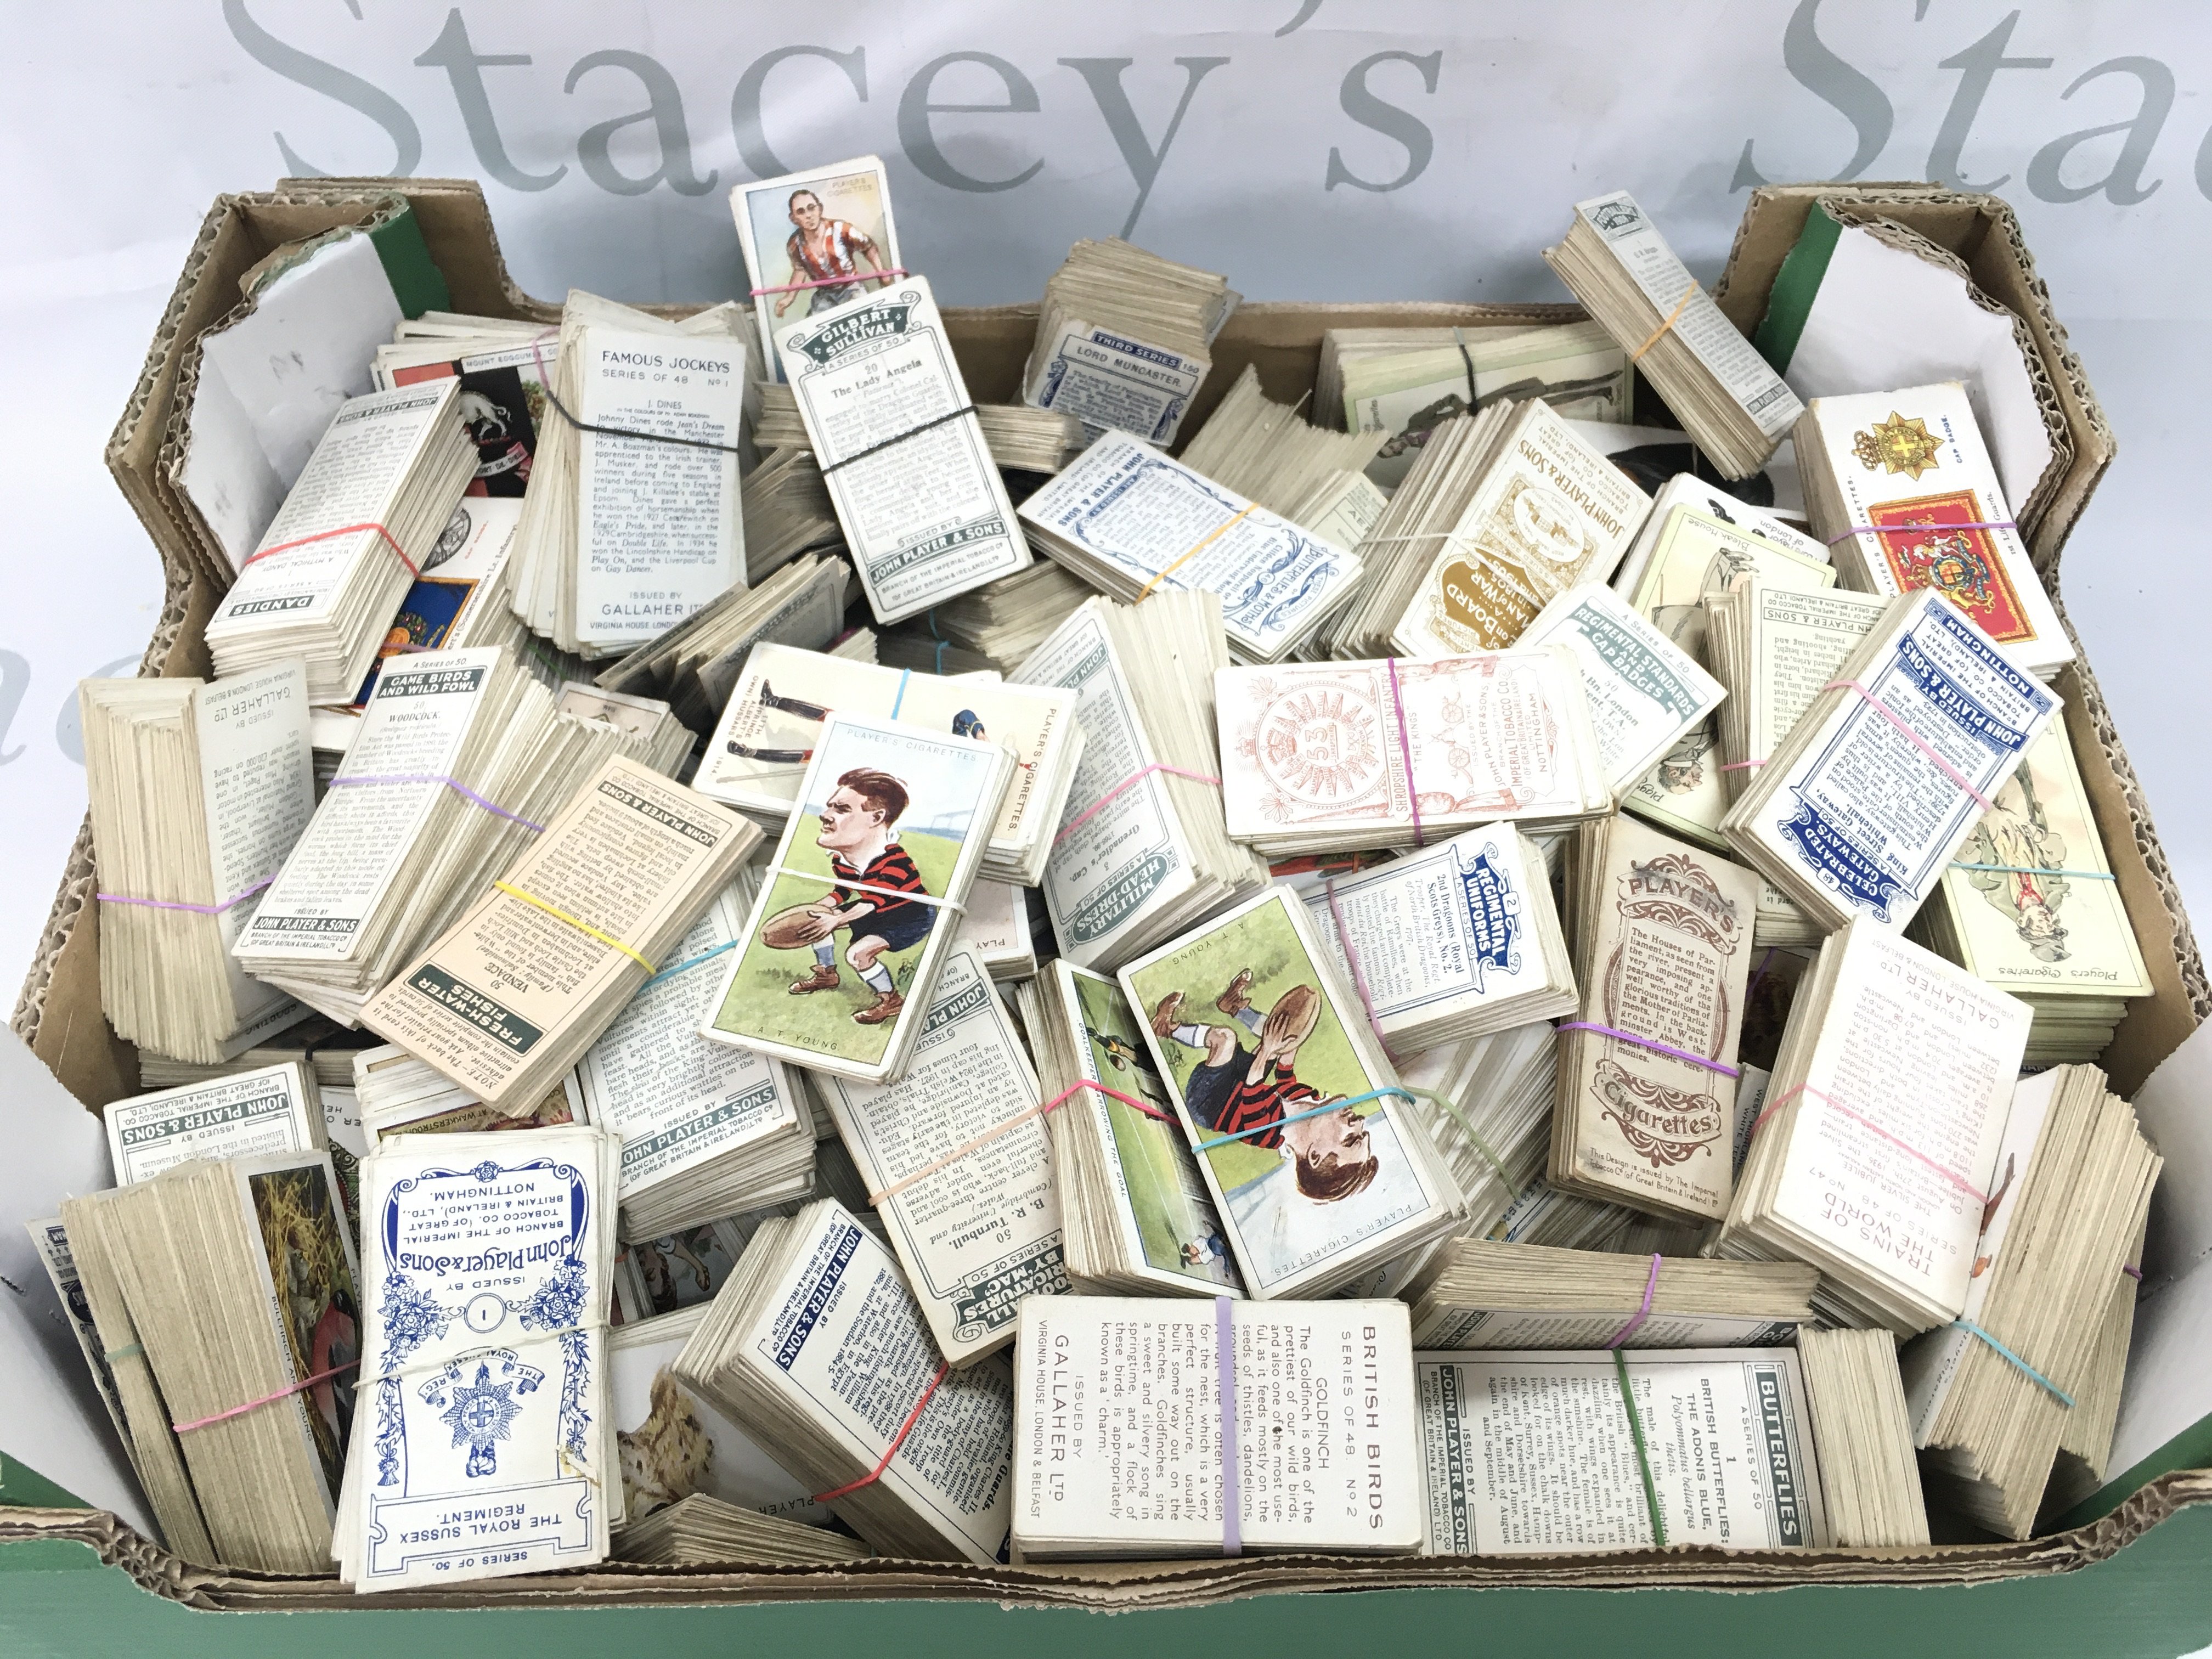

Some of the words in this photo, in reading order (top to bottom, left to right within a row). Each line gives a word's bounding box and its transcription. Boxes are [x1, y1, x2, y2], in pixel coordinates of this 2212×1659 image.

[1729, 0, 2212, 206] Sta
[818, 304, 893, 343] GILBERT
[823, 318, 898, 357] SULLIVAN
[602, 351, 663, 368] FAMOUS
[669, 357, 730, 374] JOCKEYS
[1076, 346, 1109, 363] LORD
[1096, 336, 1134, 353] THIRD
[1135, 348, 1178, 366] SERIES
[831, 383, 853, 399] The
[854, 373, 882, 391] Lady
[885, 358, 923, 380] Angela
[597, 414, 624, 424] Johnny
[629, 416, 651, 425] Dines
[656, 418, 674, 427] rode
[657, 400, 682, 409] DINES
[1119, 452, 1148, 472] JOHN
[1514, 438, 1550, 474] SONS
[1545, 463, 1559, 479] &
[1953, 447, 1962, 464] CAP
[1080, 498, 1093, 506] &
[1088, 472, 1125, 499] PLAYER
[1550, 471, 1599, 516] PLAYER
[1056, 506, 1084, 527] SONS
[1590, 505, 1624, 539] JOHN
[1686, 516, 1718, 537] House
[869, 556, 904, 582] JOHN
[902, 536, 949, 565] PLAYER
[951, 531, 965, 544] &
[964, 517, 1003, 544] SONS
[1719, 530, 1750, 552] Bleak
[1266, 548, 1324, 595] BUTTERFLIES
[1468, 570, 1501, 602] WAR
[1874, 550, 1897, 599] PLAYER'S
[231, 597, 310, 615] DANDIES
[602, 603, 683, 616] GALLAHER
[1237, 598, 1273, 627] MOTHS
[1263, 592, 1275, 601] &
[1443, 582, 1500, 635] BOARD
[1574, 605, 1643, 659] REGIMENTAL
[1640, 652, 1695, 716] STANDARDS
[1590, 629, 1616, 661] CAP
[1612, 654, 1664, 700] BADGES
[1899, 635, 1932, 679] SONS.
[1940, 616, 2032, 695] NOTTINGHAM.
[379, 686, 406, 697] AND
[405, 683, 441, 695] WILD
[439, 680, 478, 692] FOWL
[389, 674, 425, 686] GAME
[427, 670, 473, 684] BIRDS
[1926, 673, 1942, 690] &
[230, 686, 291, 715] GALLAHER
[1604, 691, 1639, 727] London
[1936, 683, 1987, 728] PLAYER
[1032, 707, 1057, 758] PLAYER'S
[1386, 723, 1401, 752] LIGHT
[1499, 697, 1515, 743] TOBACCO
[1982, 719, 2022, 747] JOHN
[1390, 755, 1408, 812] SHROPSHIRE
[1508, 744, 1522, 786] IMPERIAL
[1007, 760, 1038, 833] CIGARETTES.
[1809, 788, 1858, 828] Gateway,
[1843, 803, 1889, 845] Whitehall.
[1853, 826, 1886, 854] Street
[1090, 823, 1141, 868] Grenadier's
[1801, 826, 1880, 897] CELEBRATED
[1811, 819, 1880, 883] GATEWAYS.
[1884, 851, 1911, 874] King
[1074, 857, 1162, 932] HEAD-DRESS
[1084, 876, 1158, 938] MILITARY
[1475, 866, 1507, 956] REGIMENTAL
[1627, 864, 1736, 935] PLAYER'S
[1465, 877, 1491, 952] UNIFORMS
[1441, 893, 1457, 939] Dragoons
[1449, 940, 1465, 974] (Royal
[1631, 927, 1647, 940] The
[1651, 934, 1681, 953] Houses
[1685, 947, 1694, 958] of
[483, 961, 531, 992] VENDACE
[489, 978, 505, 990] 50
[1628, 953, 1647, 970] very
[1656, 964, 1693, 987] imposing
[1998, 962, 2061, 979] Cigarettes
[2070, 966, 2118, 981] Player's
[414, 977, 526, 1046] FRESH-WATER
[449, 983, 509, 1022] FISHES
[1640, 995, 1671, 1015] Mother
[1906, 970, 1999, 1030] GALLAHER
[1077, 1022, 1098, 1081] GOALKEEPER
[650, 1104, 674, 1121] front
[675, 1098, 686, 1109] of
[687, 1092, 699, 1103] its
[700, 1079, 726, 1097] head.
[654, 1088, 687, 1109] curious
[690, 1072, 724, 1093] wattles
[198, 1124, 234, 1138] ISSUED
[1601, 1075, 1712, 1156] Cigarettes
[180, 1134, 192, 1142] BY
[183, 1145, 219, 1160] London
[139, 1154, 180, 1169] Museum.
[1109, 1146, 1119, 1165] THE
[1115, 1171, 1127, 1197] GOAL
[429, 1183, 534, 1200] NOTTINGHAM.
[913, 1190, 975, 1230] three-quarter
[948, 1214, 1008, 1251] Turnbull.
[1355, 1203, 1412, 1237] PLAYER'S
[1820, 1204, 1848, 1228] OF
[1824, 1190, 1893, 1238] WORLD
[835, 1227, 862, 1263] JOHN
[995, 1227, 1011, 1245] 50
[1008, 1239, 1049, 1264] SERIES
[1050, 1234, 1059, 1243] A
[1858, 1225, 1931, 1276] TRAINS
[1899, 1233, 1934, 1261] THE
[970, 1268, 989, 1283] 50
[991, 1260, 1007, 1272] OF
[806, 1261, 843, 1314] PLAYER
[272, 1296, 292, 1362] BULLFINCH
[800, 1311, 814, 1325] &
[842, 1316, 863, 1347] Soudan
[852, 1307, 878, 1347] Waterloo,
[777, 1323, 809, 1367] SONS
[1341, 1331, 1353, 1396] SERIES
[828, 1361, 850, 1392] Egypt
[1363, 1327, 1378, 1427] BRITISH
[1049, 1335, 1069, 1461] GALLAHER
[1344, 1406, 1353, 1426] OF
[1686, 1393, 1698, 1420] THE
[1701, 1378, 1716, 1434] BRITISH
[1316, 1378, 1329, 1468] GOLDFINCH
[1671, 1395, 1691, 1472] Polyommatus
[1108, 1426, 1122, 1519] appropriately
[1691, 1427, 1706, 1481] ADONIS
[1760, 1381, 1797, 1536] BUTTERFLIES
[1030, 1472, 1041, 1517] BELFAST
[1243, 1444, 1254, 1521] dandelions,
[1367, 1444, 1382, 1530] BIRDS
[1708, 1442, 1730, 1544] BUTTERFLIES:
[436, 1503, 523, 1524] REGIMENT.
[530, 1514, 561, 1527] THE
[1680, 1476, 1698, 1529] bellargus
[1698, 1489, 1712, 1530] BLUE,
[399, 1526, 460, 1543] SUSSEX
[470, 1519, 519, 1535] ROYAL
